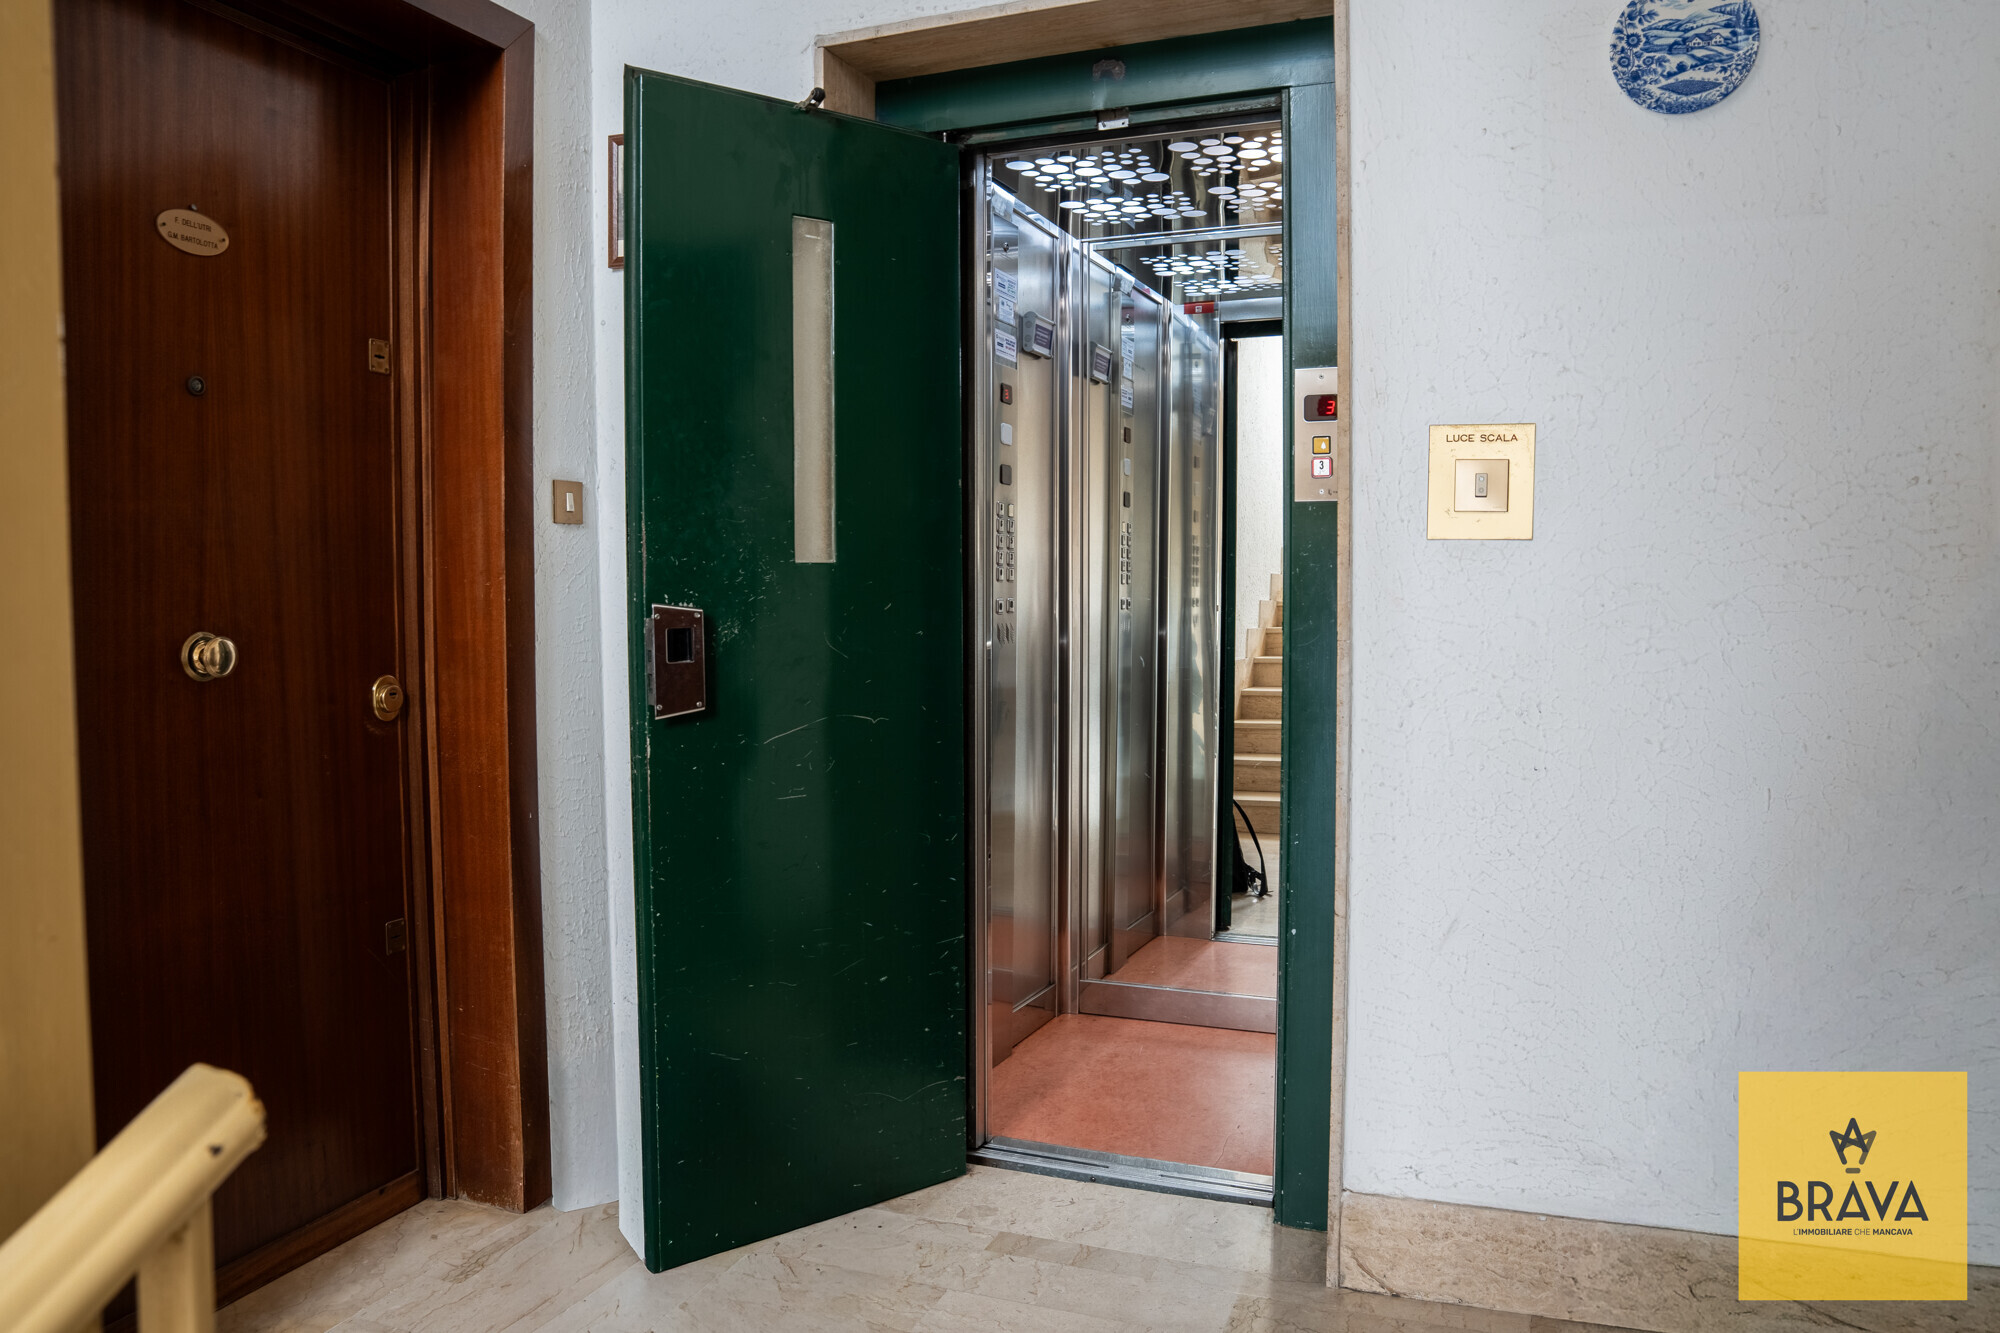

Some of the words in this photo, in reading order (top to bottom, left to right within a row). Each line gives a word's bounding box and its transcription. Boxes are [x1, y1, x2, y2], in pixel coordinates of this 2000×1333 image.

[1325, 400, 1335, 415] 3
[1446, 434, 1475, 442] LUCE
[1480, 434, 1518, 442] SCALA
[1319, 460, 1324, 470] 3
